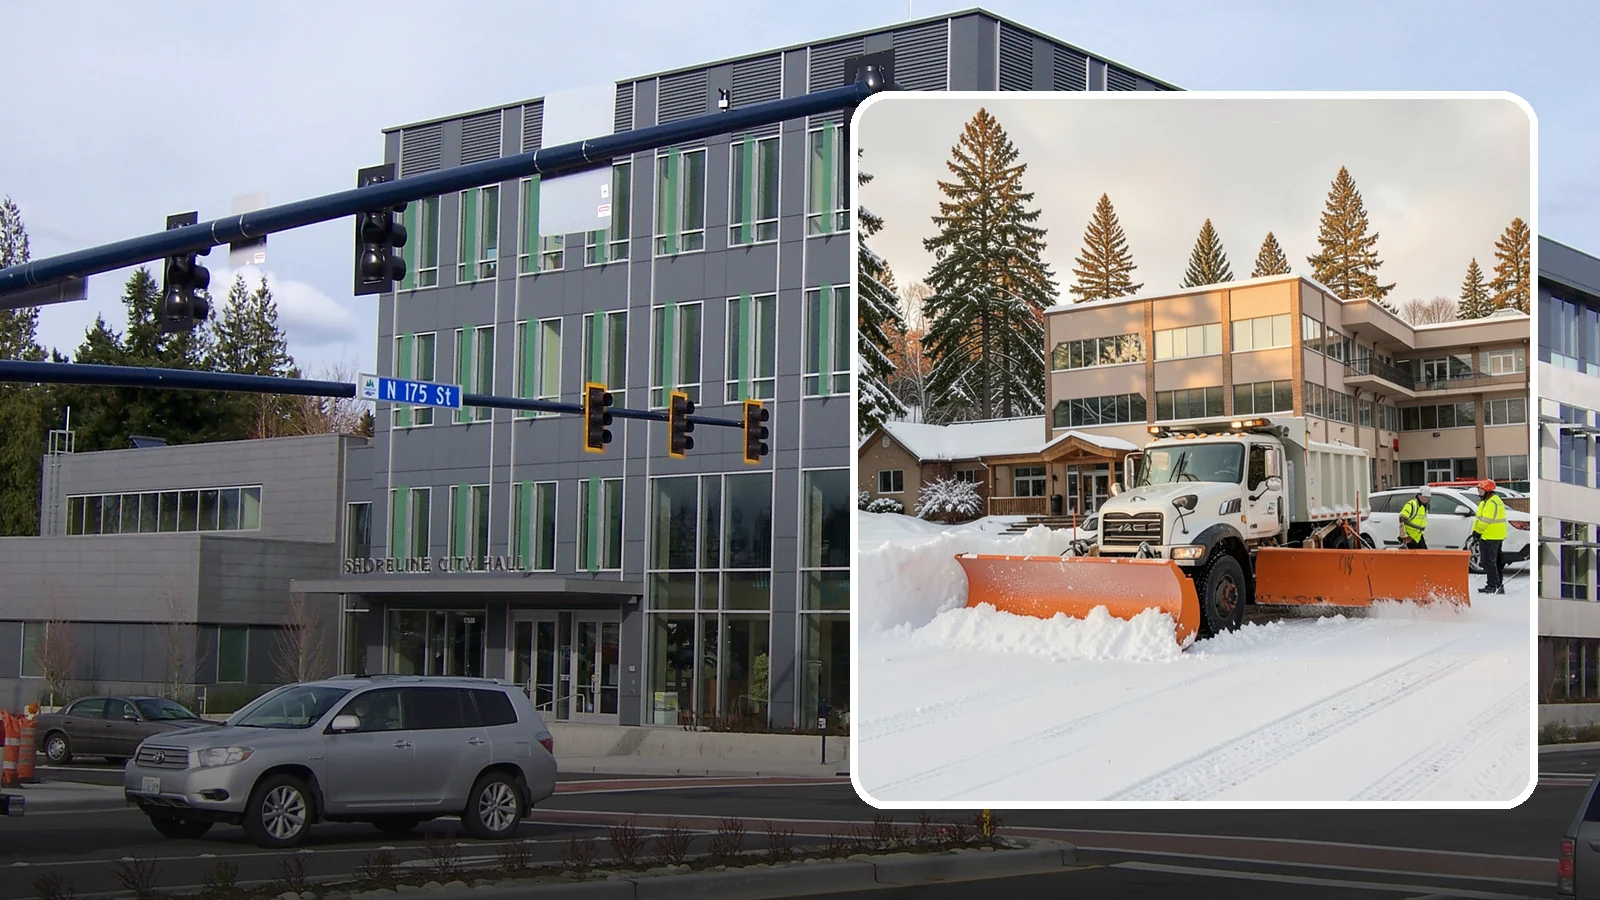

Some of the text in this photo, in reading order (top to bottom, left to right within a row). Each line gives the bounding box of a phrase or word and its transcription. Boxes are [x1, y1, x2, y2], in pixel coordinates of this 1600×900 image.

[387, 380, 451, 406] N 175 St
[344, 555, 526, 574] SHORELINE CITY HALL
